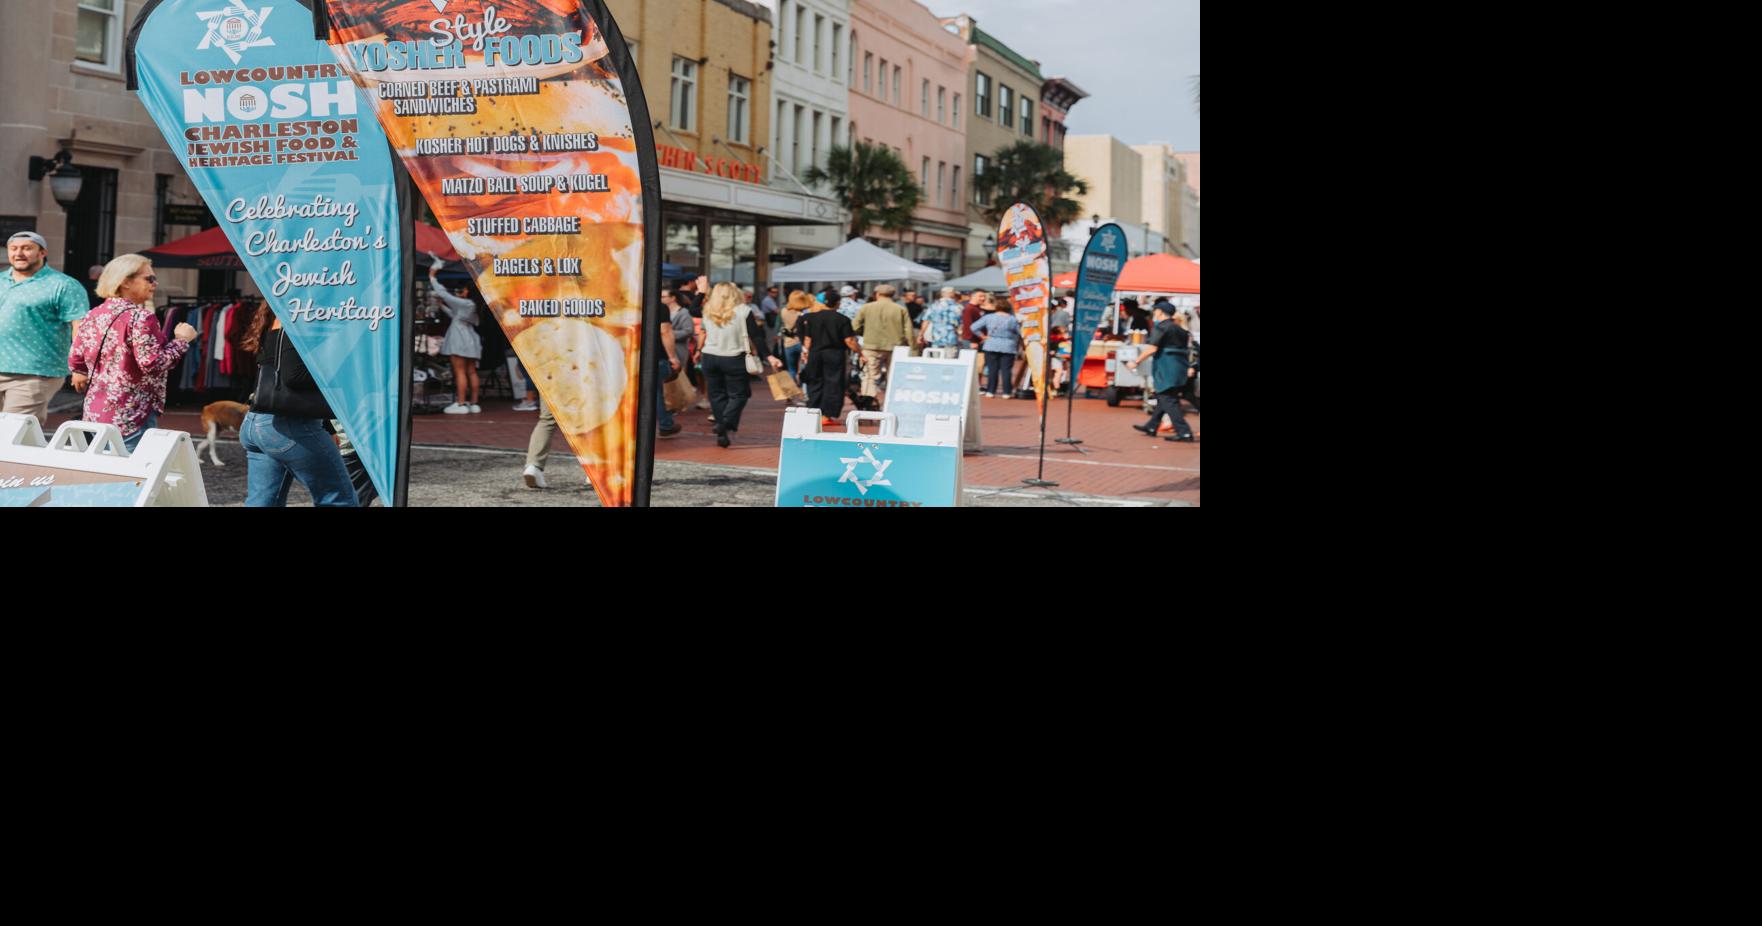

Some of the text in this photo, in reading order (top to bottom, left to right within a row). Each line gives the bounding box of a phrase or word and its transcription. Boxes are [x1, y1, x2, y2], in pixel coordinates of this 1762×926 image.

[429, 6, 512, 51] Style
[484, 30, 583, 67] FOODS
[180, 63, 351, 85] LOWCOUNTRY
[378, 77, 539, 99] CORNED BEEF & PASTRAMI
[183, 81, 357, 123] NOSH
[394, 97, 476, 115] SANDWICHES
[184, 119, 358, 141] CHARLESTON
[188, 135, 359, 156] JEWISH FOOD &
[416, 133, 597, 155] KOSHER HOT DOGS & KNISHES
[188, 150, 359, 168] HERITAGE FESTIVAL
[705, 154, 760, 184] SCOTT
[442, 174, 609, 195] MATZO BALL SOUP & KUGEL
[225, 194, 359, 226] Celebrating
[468, 216, 580, 235] STUFFED CABBAGE
[245, 225, 388, 256] Charleston's
[493, 258, 581, 275] BAGELS & LOX
[1086, 256, 1118, 272] NOSH
[272, 261, 356, 296] Jewish
[288, 297, 395, 331] Heritage
[520, 299, 604, 316] BAKED GOODS
[895, 389, 961, 405] NOSH
[30, 474, 55, 487] us
